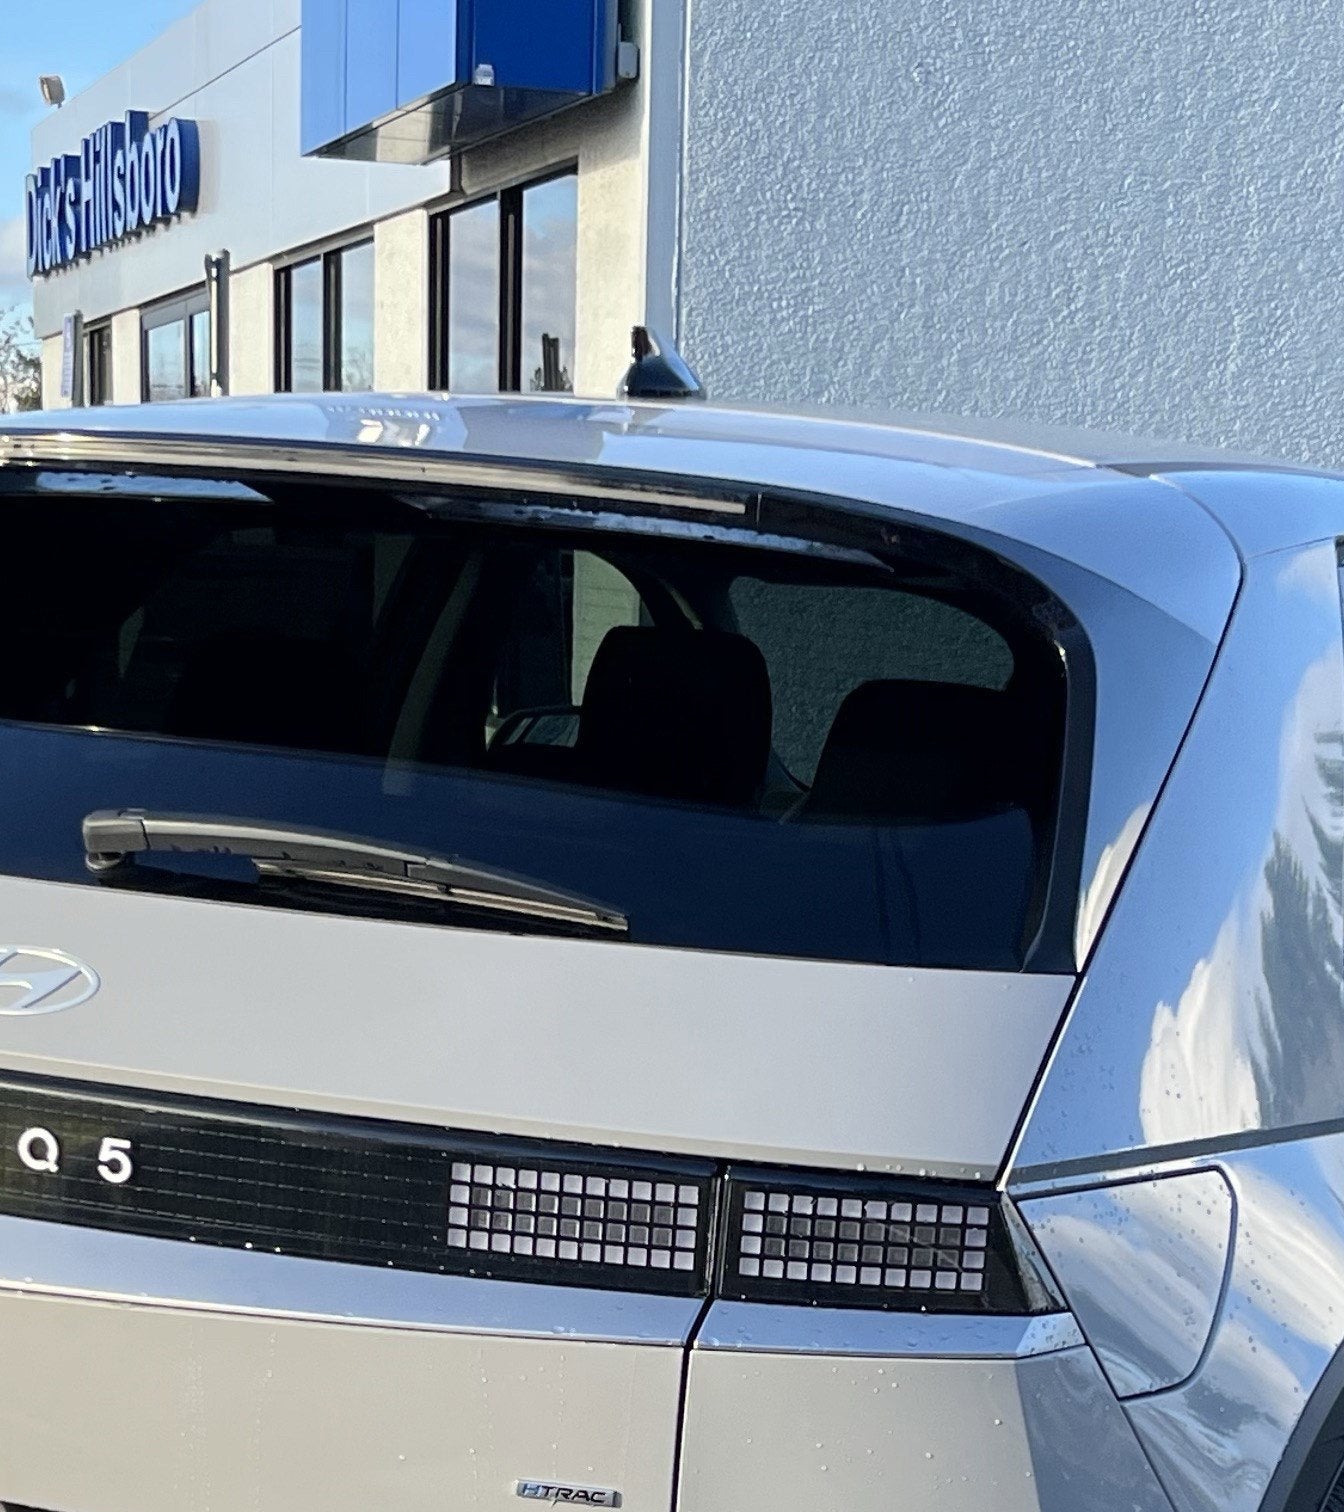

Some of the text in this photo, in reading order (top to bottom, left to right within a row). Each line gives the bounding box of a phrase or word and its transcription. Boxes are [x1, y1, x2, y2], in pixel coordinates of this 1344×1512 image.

[26, 110, 186, 280] Dick's Hillsboro
[97, 1136, 134, 1185] 5
[521, 1483, 607, 1504] HTRAC
